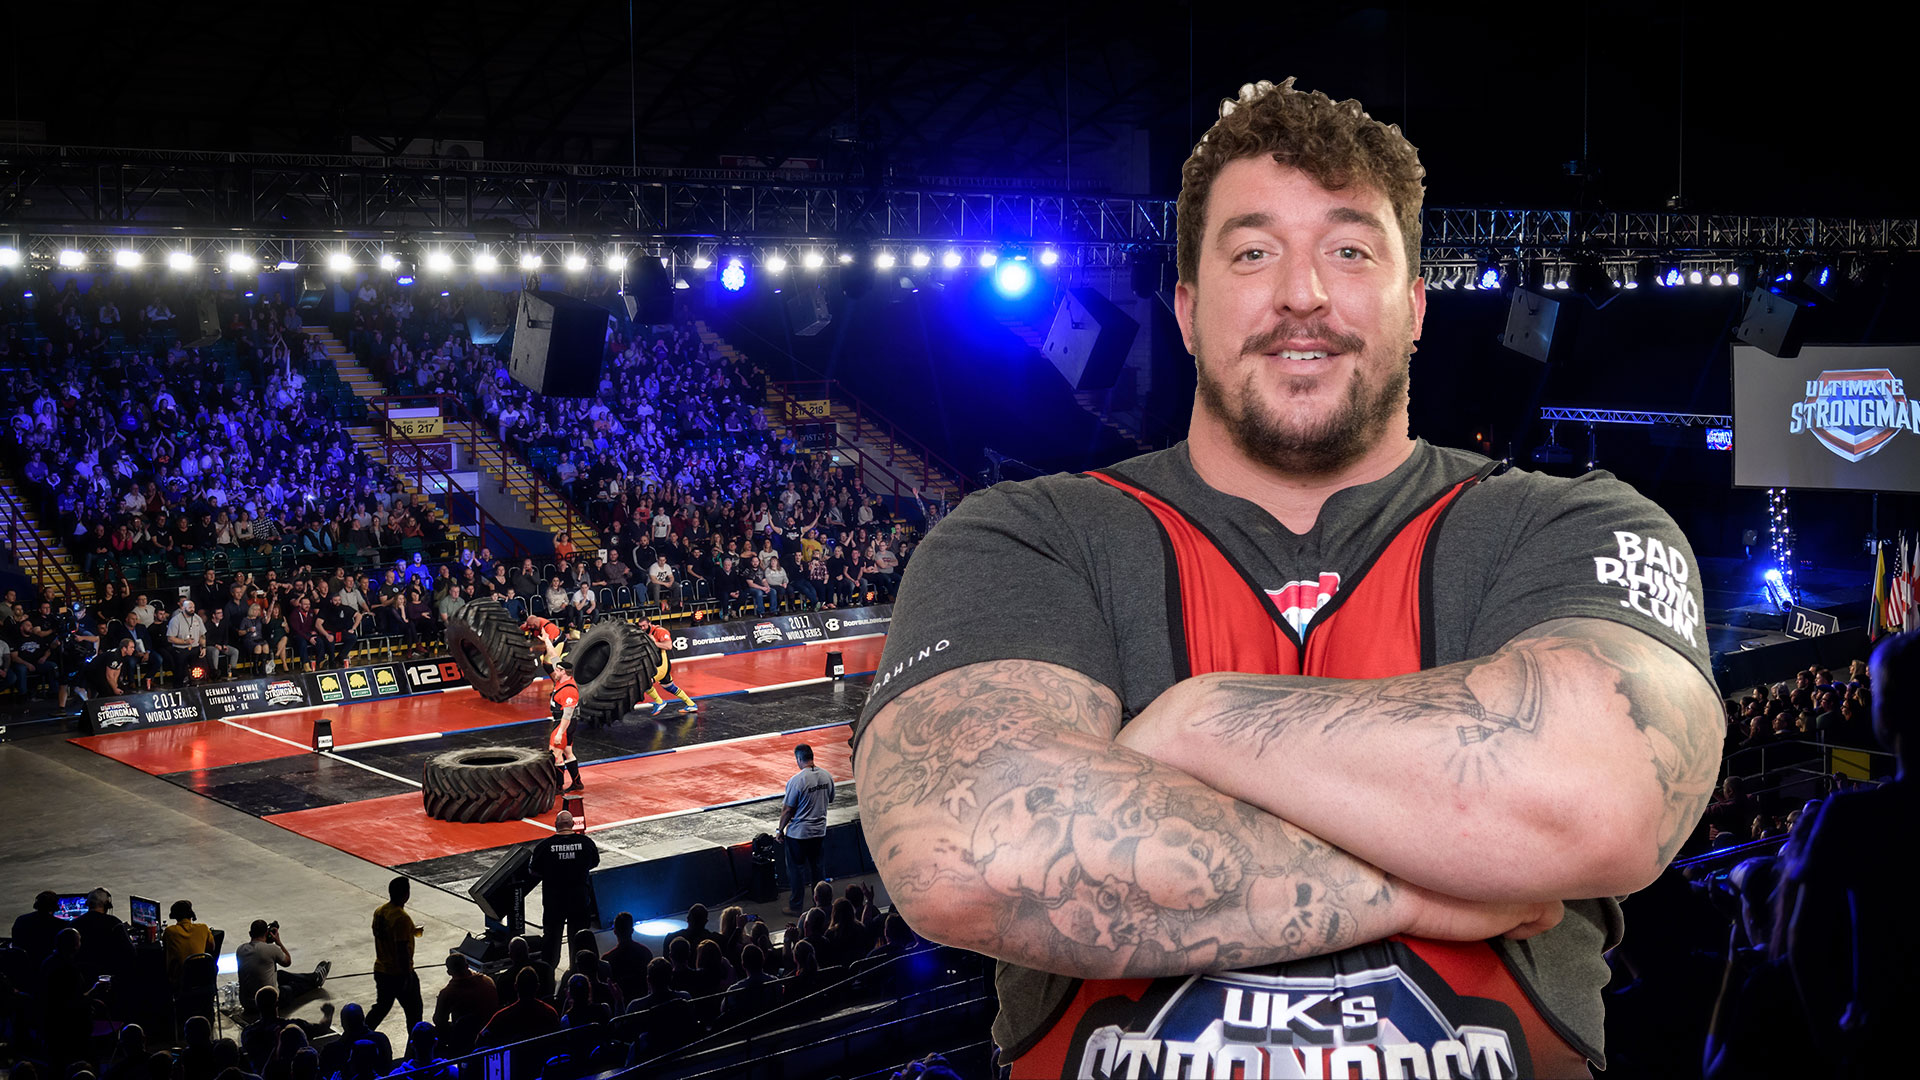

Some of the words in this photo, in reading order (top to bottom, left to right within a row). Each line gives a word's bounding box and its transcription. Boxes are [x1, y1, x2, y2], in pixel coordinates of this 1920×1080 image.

[1805, 378, 1904, 397] ULTIMATE
[809, 405, 824, 415] 218
[1789, 398, 1920, 435] STRONGMAN
[417, 423, 435, 434] 217
[1613, 531, 1689, 584] BAD
[1593, 556, 1699, 627] RHINO
[788, 615, 810, 630] 2017
[1620, 589, 1697, 648] .COM
[1793, 612, 1826, 638] Dave
[785, 630, 805, 641] WORLD
[804, 627, 823, 638] SERIES
[406, 662, 465, 686] 12B
[204, 687, 230, 697] GERMANY
[236, 683, 259, 693] NORWAY
[264, 686, 304, 700] STRONGMAN
[152, 691, 183, 709] 2017
[208, 695, 238, 706] LITHUANIA
[242, 692, 260, 701] CHINA
[97, 707, 140, 722] STRONGMAN
[145, 709, 172, 723] WORLD
[173, 706, 198, 719] SERIES
[223, 704, 236, 713] USA
[240, 702, 249, 711] UK
[550, 843, 583, 853] STRENGTH
[558, 851, 576, 860] TEAM
